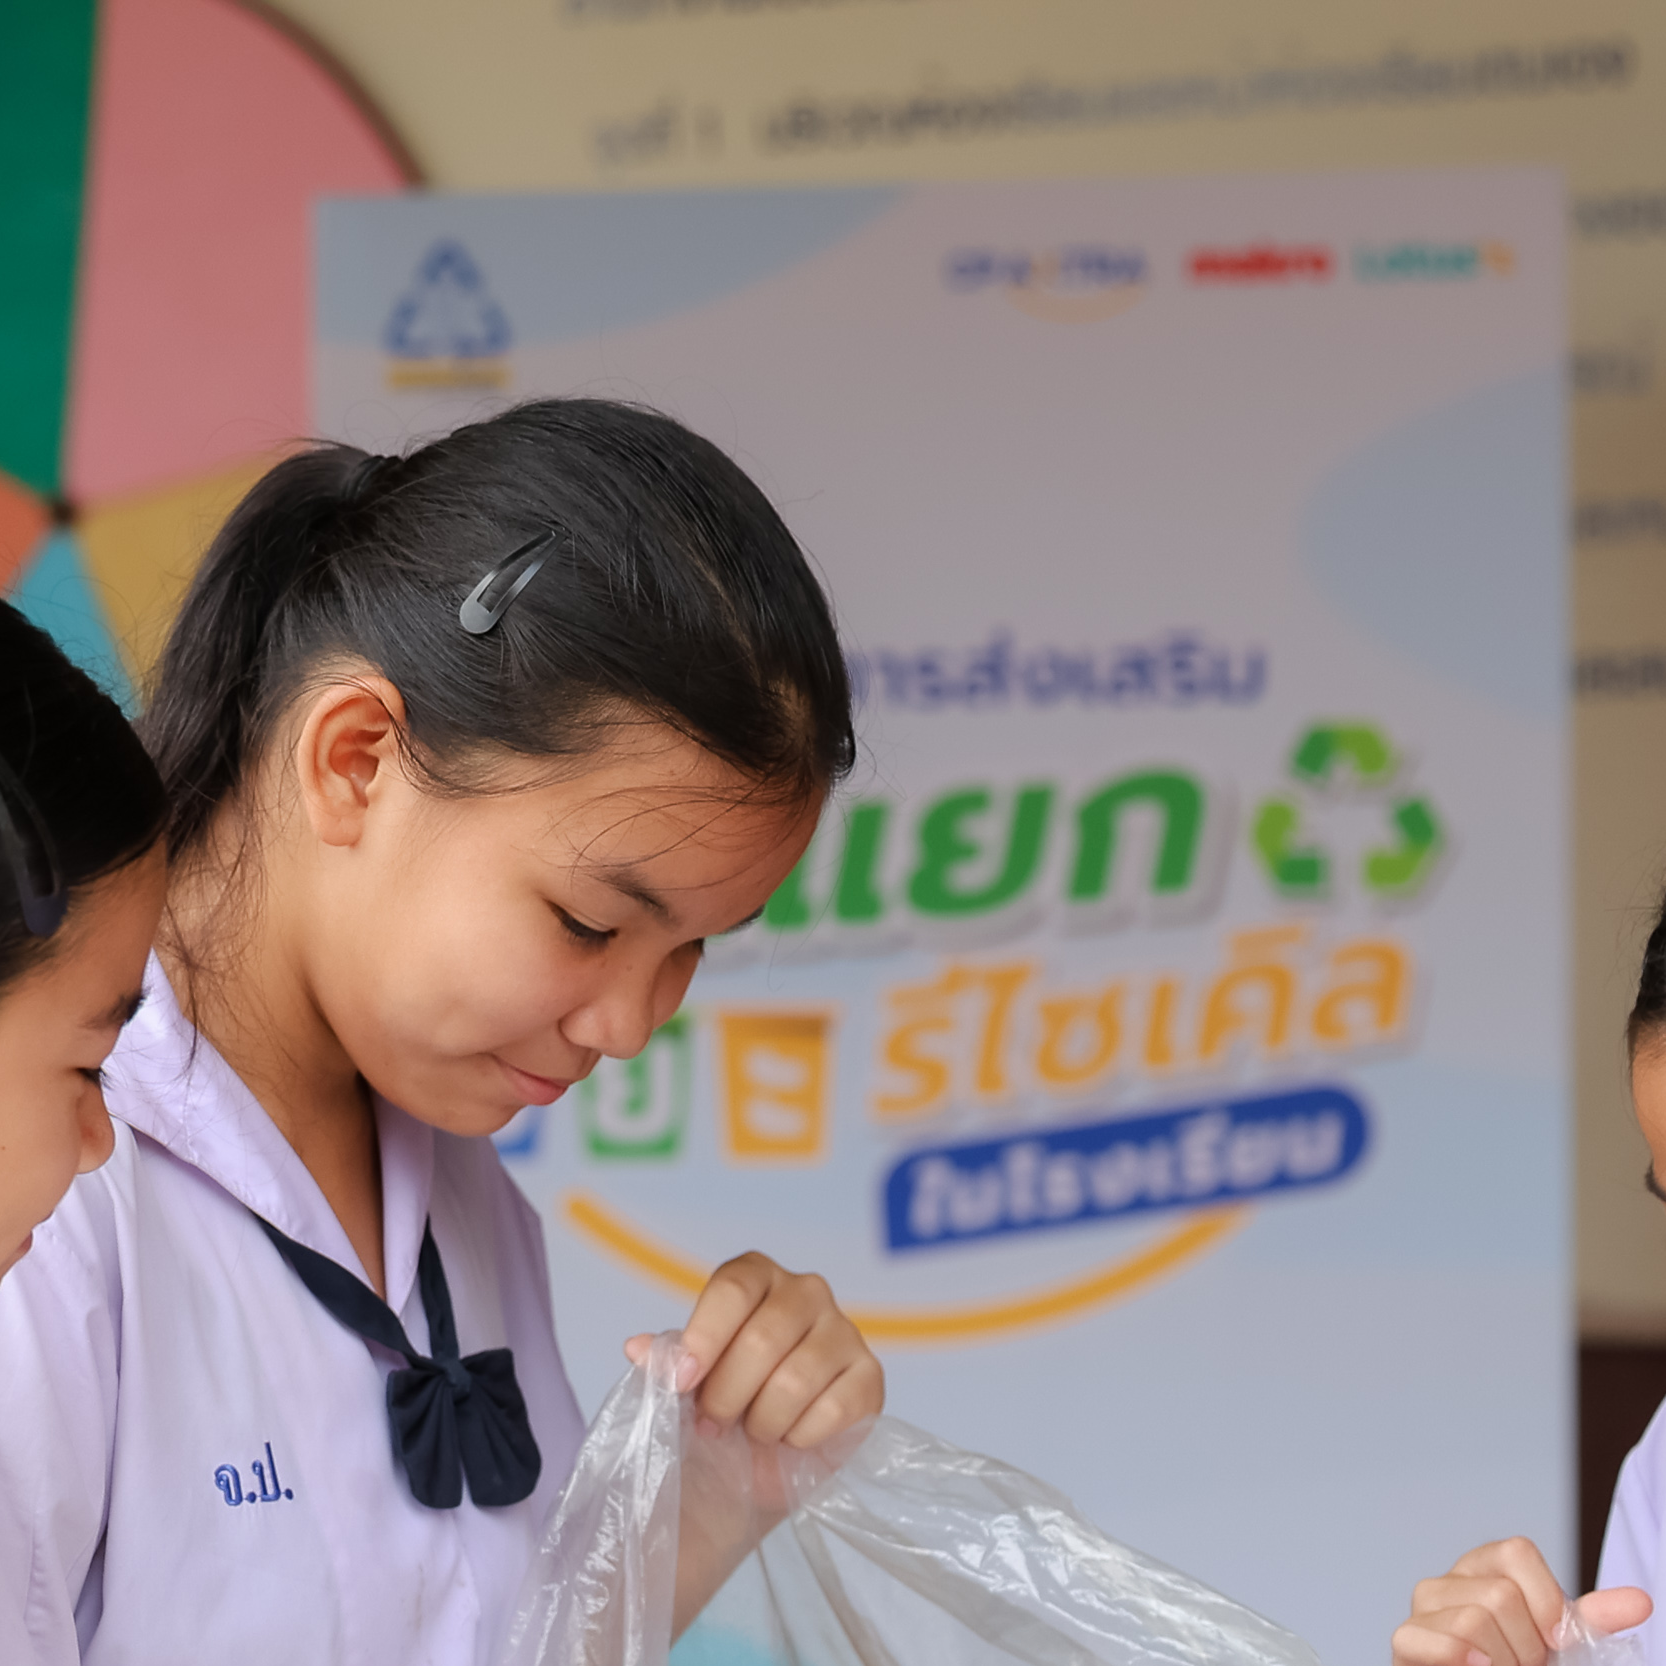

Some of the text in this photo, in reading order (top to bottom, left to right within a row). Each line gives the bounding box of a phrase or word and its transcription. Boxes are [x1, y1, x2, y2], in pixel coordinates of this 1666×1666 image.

[873, 926, 1410, 1121] รีไซเคิล
[906, 1105, 1346, 1237] ในโรงเรียน
